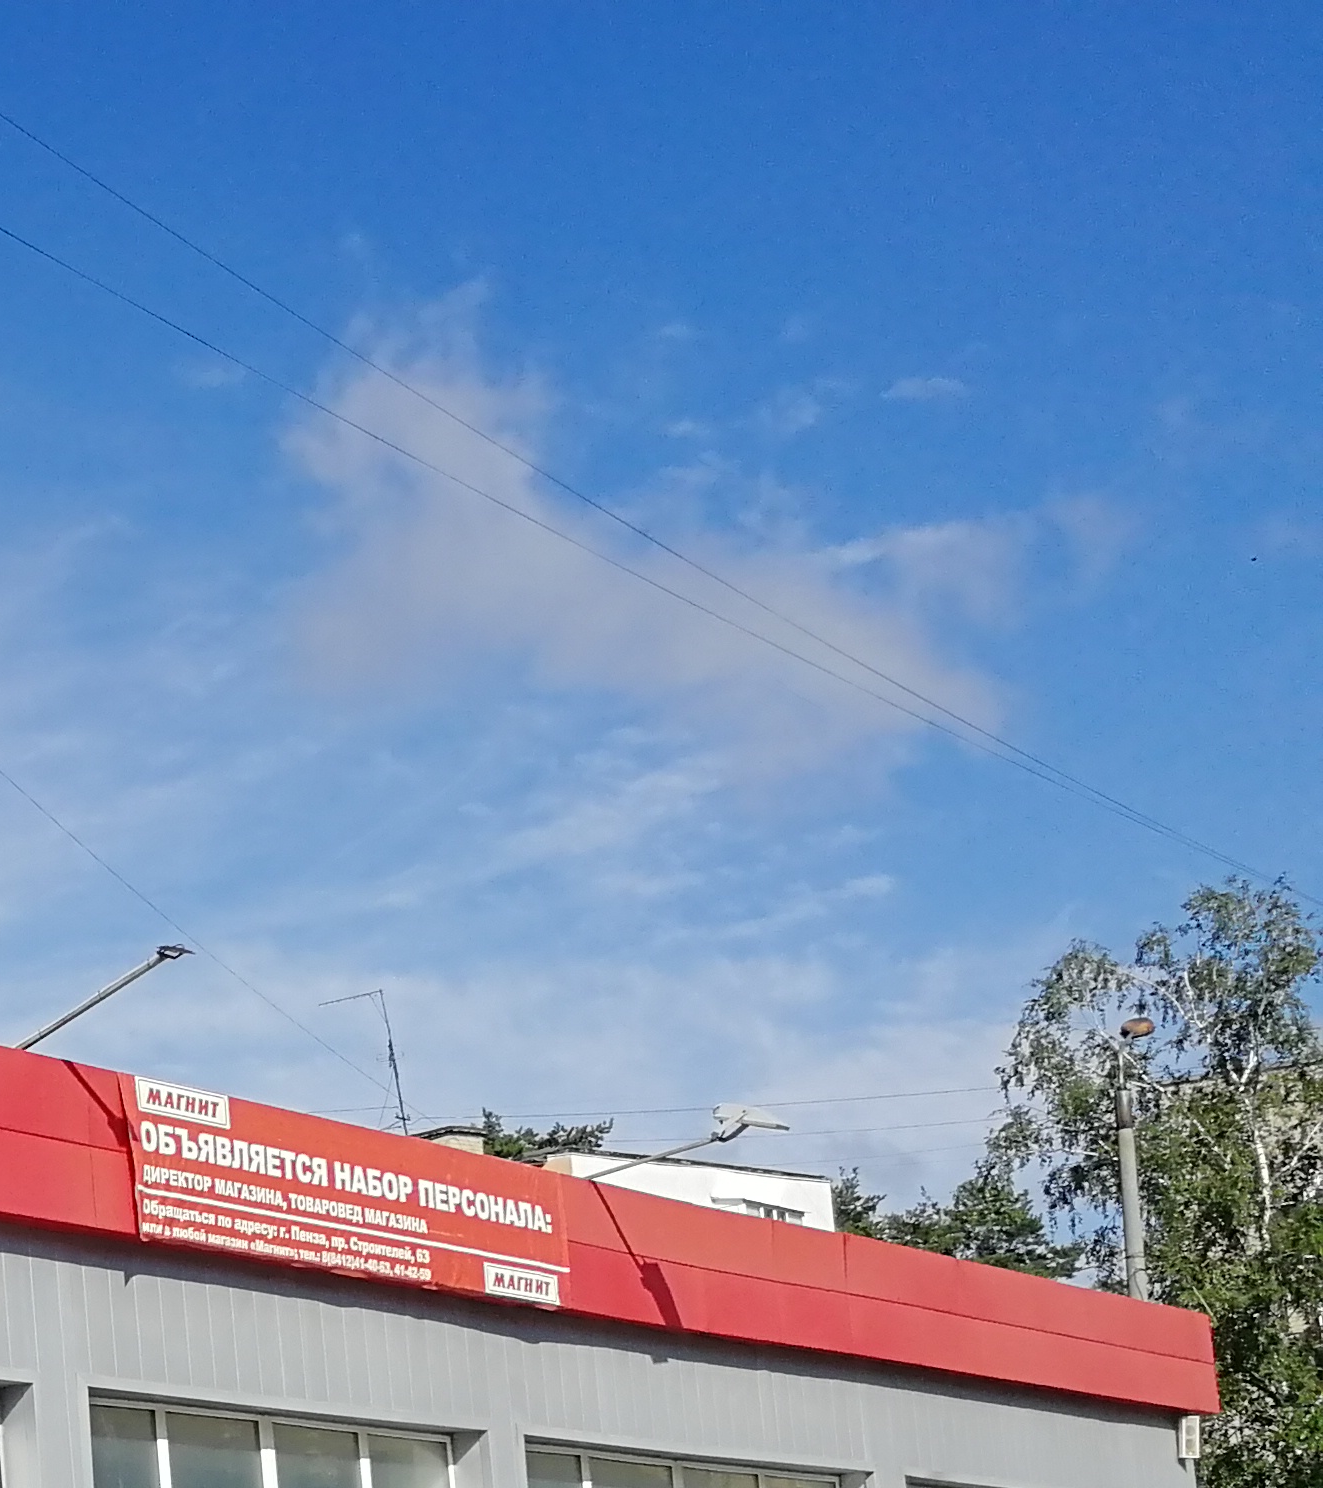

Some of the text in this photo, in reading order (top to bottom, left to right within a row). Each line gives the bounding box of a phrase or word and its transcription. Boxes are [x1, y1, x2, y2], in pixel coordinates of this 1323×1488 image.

[146, 1088, 219, 1118] МАГНИТ
[140, 1121, 553, 1234] ОБЪЯВЛЯЕТСЯ НАБОР ПЕРСОНАЛА:
[143, 1164, 428, 1234] ДИРЕКТОР МАГАЗИНА, ТОВАРОВЕД МАГАЗИНА
[143, 1199, 430, 1264] Обращаться по адресу: г. Пенза, пр. Строителей, 63
[493, 1272, 551, 1296] МАГНИТ
